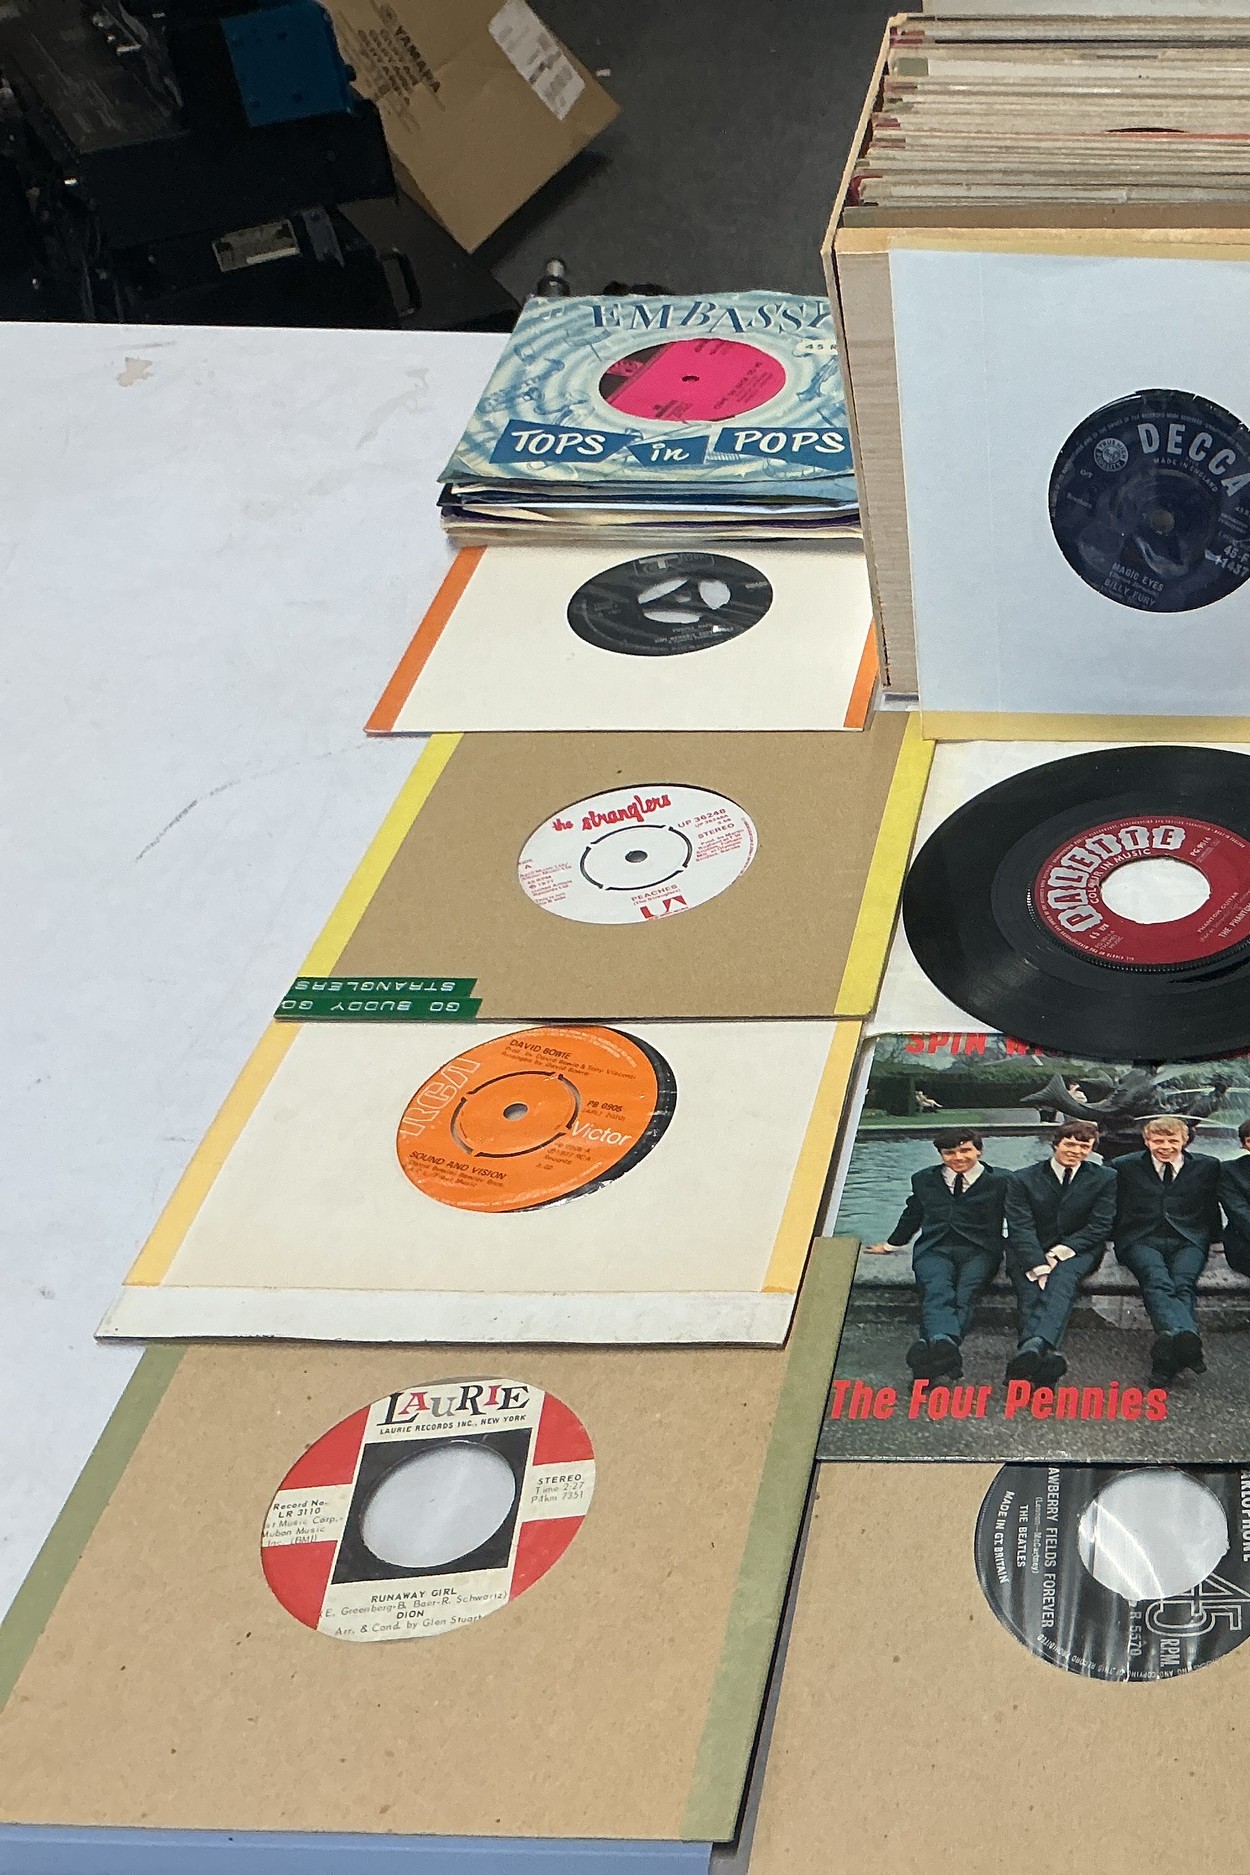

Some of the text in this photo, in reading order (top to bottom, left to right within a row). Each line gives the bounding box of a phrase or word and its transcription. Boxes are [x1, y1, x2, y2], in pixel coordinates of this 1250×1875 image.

[592, 301, 832, 334] EMBASSY
[511, 430, 846, 462] TOPS in POPS
[1153, 457, 1178, 466] MADE
[1189, 465, 1219, 492] ENGLAND
[1112, 562, 1140, 580] MAGIC
[1142, 576, 1164, 592] EYES
[1104, 578, 1130, 595] BILLY
[1131, 590, 1156, 607] FURY
[552, 794, 671, 832] the stranglers
[677, 819, 692, 828] UP
[698, 823, 735, 839] STEREO
[1051, 826, 1180, 931] PALETTE
[1087, 848, 1152, 904] COLOUR IN MUSIC
[631, 884, 678, 901] PEACHES
[1197, 892, 1239, 933] PHANTOM GUITAR
[1217, 926, 1233, 938] THE
[294, 980, 457, 992] STRANGLERS
[281, 1000, 461, 1012] GO BUDDY GO
[509, 1039, 573, 1060] DAVID BOWIE
[905, 1033, 987, 1056] SPIN
[400, 1057, 481, 1137] RCA
[586, 1100, 600, 1108] PB
[571, 1119, 633, 1146] Victor
[409, 1150, 445, 1165] SOUND
[446, 1160, 470, 1171] AND
[471, 1166, 507, 1180] VISION
[831, 1377, 1168, 1422] The Four Pennies
[379, 1425, 413, 1435] LAURIE
[414, 1421, 454, 1432] RECORDS
[480, 1416, 500, 1425] NEW
[503, 1414, 527, 1422] YORK
[538, 1473, 582, 1485] STEREO
[535, 1486, 559, 1495] Time
[561, 1490, 584, 1500] 7351
[273, 1500, 308, 1511] Record
[278, 1507, 321, 1519] LR 3110
[998, 1490, 1016, 1517] MADE
[295, 1527, 325, 1535] Music
[995, 1520, 1006, 1530] IN
[1016, 1504, 1029, 1568] THE BEATLES
[1042, 1467, 1061, 1628] AWBERRY FIELDS FOREVER
[370, 1587, 457, 1603] RUNAWAY GIRL
[334, 1626, 356, 1636] Arr.
[360, 1623, 369, 1633] &
[406, 1621, 418, 1631] by
[422, 1617, 447, 1627] Glen
[450, 1614, 482, 1624] Stuart
[396, 1609, 425, 1620] DION
[1129, 1611, 1142, 1656] R 5570
